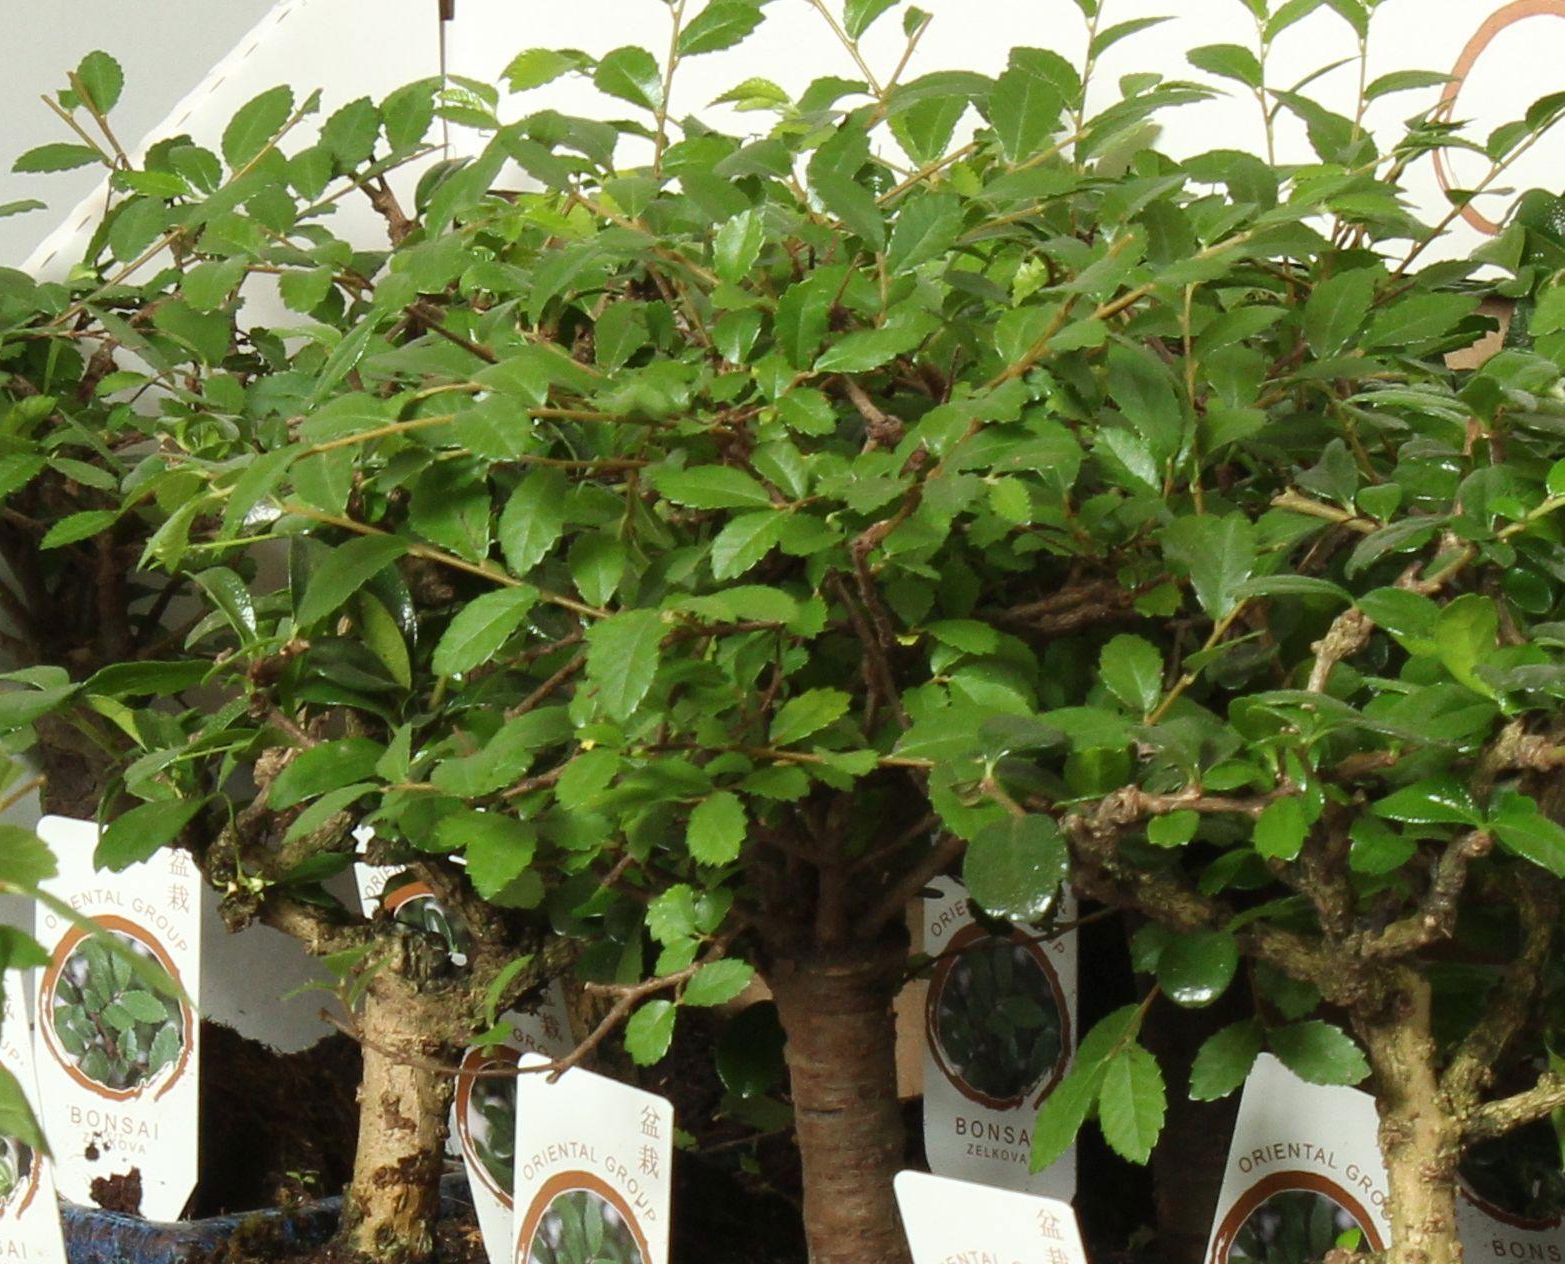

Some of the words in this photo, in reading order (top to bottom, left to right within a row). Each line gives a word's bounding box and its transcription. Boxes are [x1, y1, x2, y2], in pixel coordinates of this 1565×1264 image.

[45, 889, 124, 929] OENTAL
[132, 897, 188, 951] GROUP
[70, 1105, 159, 1141] BONSAI
[638, 1105, 662, 1180] 盆栽
[955, 1116, 1031, 1148] BONSA
[966, 1142, 1028, 1165] ZELKOVA
[522, 1141, 598, 1181] ORIENTAL
[604, 1155, 657, 1222] GROUP
[1237, 1142, 1339, 1174] ORIENTAL
[1345, 1163, 1393, 1221] GRO
[1491, 1239, 1562, 1263] BONS
